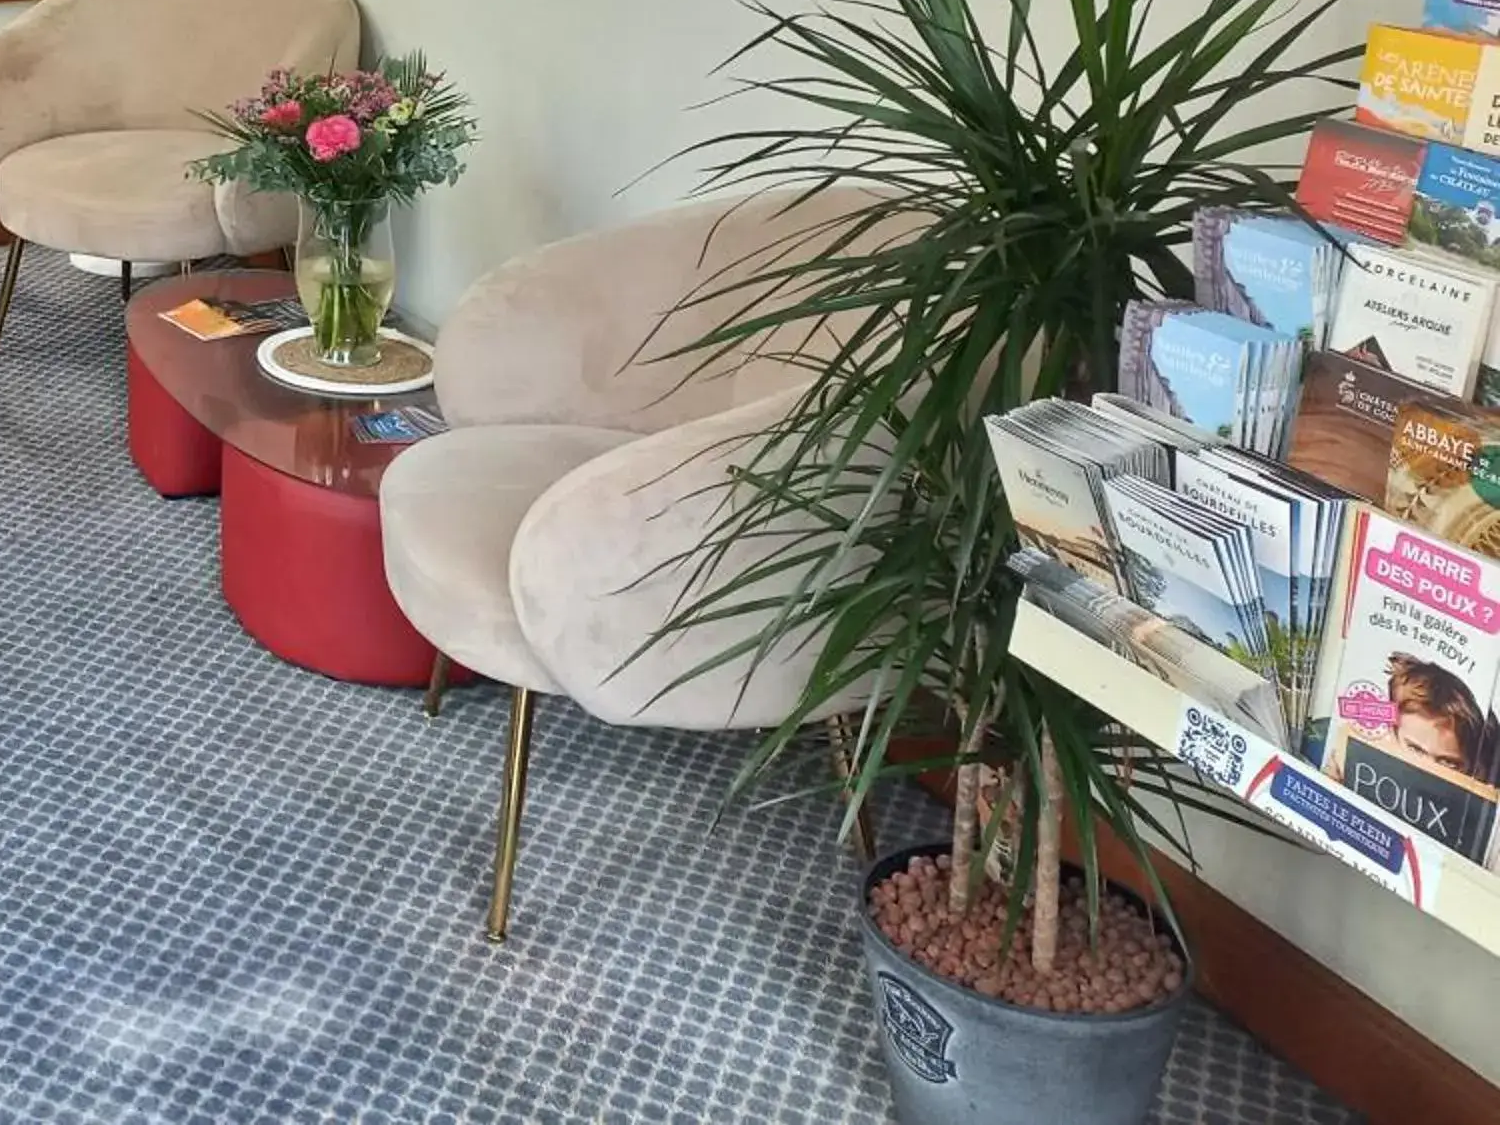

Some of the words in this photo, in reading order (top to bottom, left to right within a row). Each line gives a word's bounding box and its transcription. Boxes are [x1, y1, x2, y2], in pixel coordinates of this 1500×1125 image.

[1363, 261, 1472, 303] PORCELAINE
[1363, 299, 1410, 322] ATELIERS
[1402, 419, 1475, 462] ABBAYE
[1183, 481, 1278, 538] BOURDEILLES
[1117, 510, 1210, 569] BOURDEILLES
[1402, 541, 1473, 586] MARRE
[1376, 559, 1414, 588] DES
[1417, 578, 1478, 618] POUX
[1368, 612, 1393, 630] dès
[1395, 619, 1409, 636] le
[1411, 626, 1435, 646] 1er
[1436, 639, 1469, 666] RDV
[1382, 596, 1407, 616] Fini
[1409, 605, 1421, 620] la
[1424, 613, 1468, 646] galère
[1285, 774, 1331, 810] FAITES
[1332, 801, 1350, 823] LE
[1350, 813, 1393, 849] PLEIN
[1353, 762, 1449, 838] POUX
